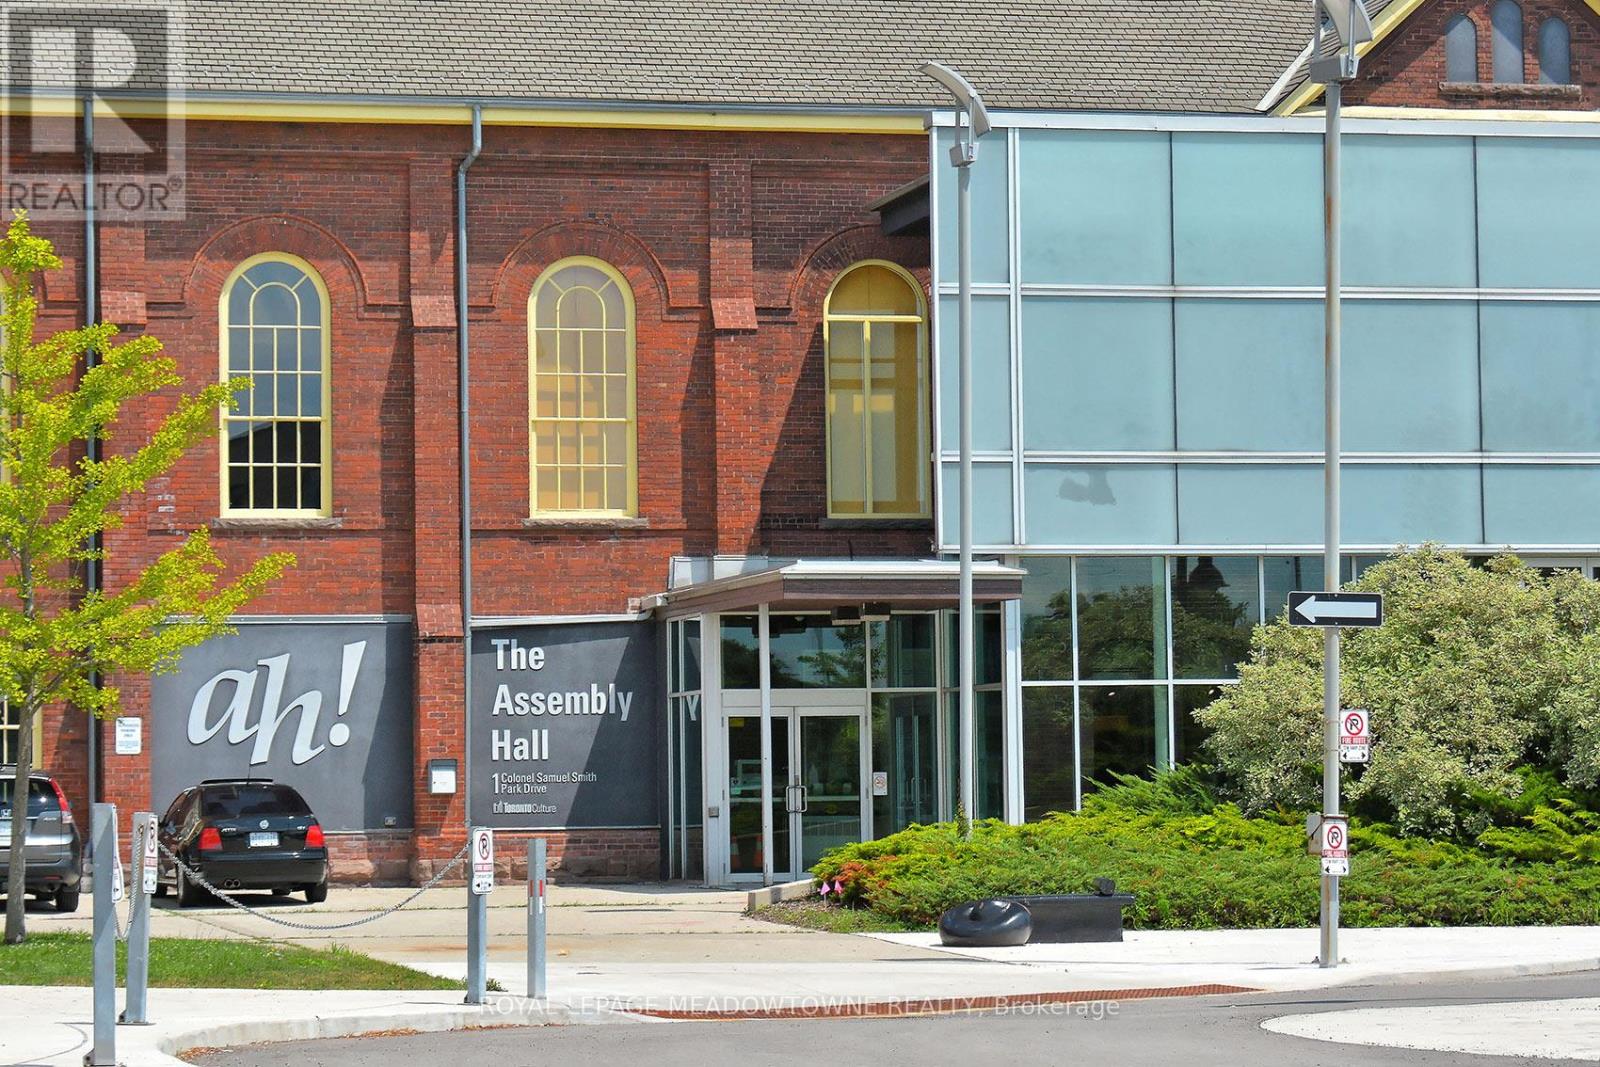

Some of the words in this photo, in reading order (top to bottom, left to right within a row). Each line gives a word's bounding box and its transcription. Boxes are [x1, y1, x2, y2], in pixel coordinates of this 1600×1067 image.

[491, 638, 545, 670] The
[187, 640, 367, 766] ah!
[492, 683, 633, 721] Assembly
[491, 728, 549, 761] Hall
[491, 772, 499, 794] 1
[501, 772, 535, 783] Colonel
[536, 772, 570, 783] Samuel
[571, 771, 597, 782] Smith
[501, 783, 522, 794] Park
[523, 783, 547, 794] Drive
